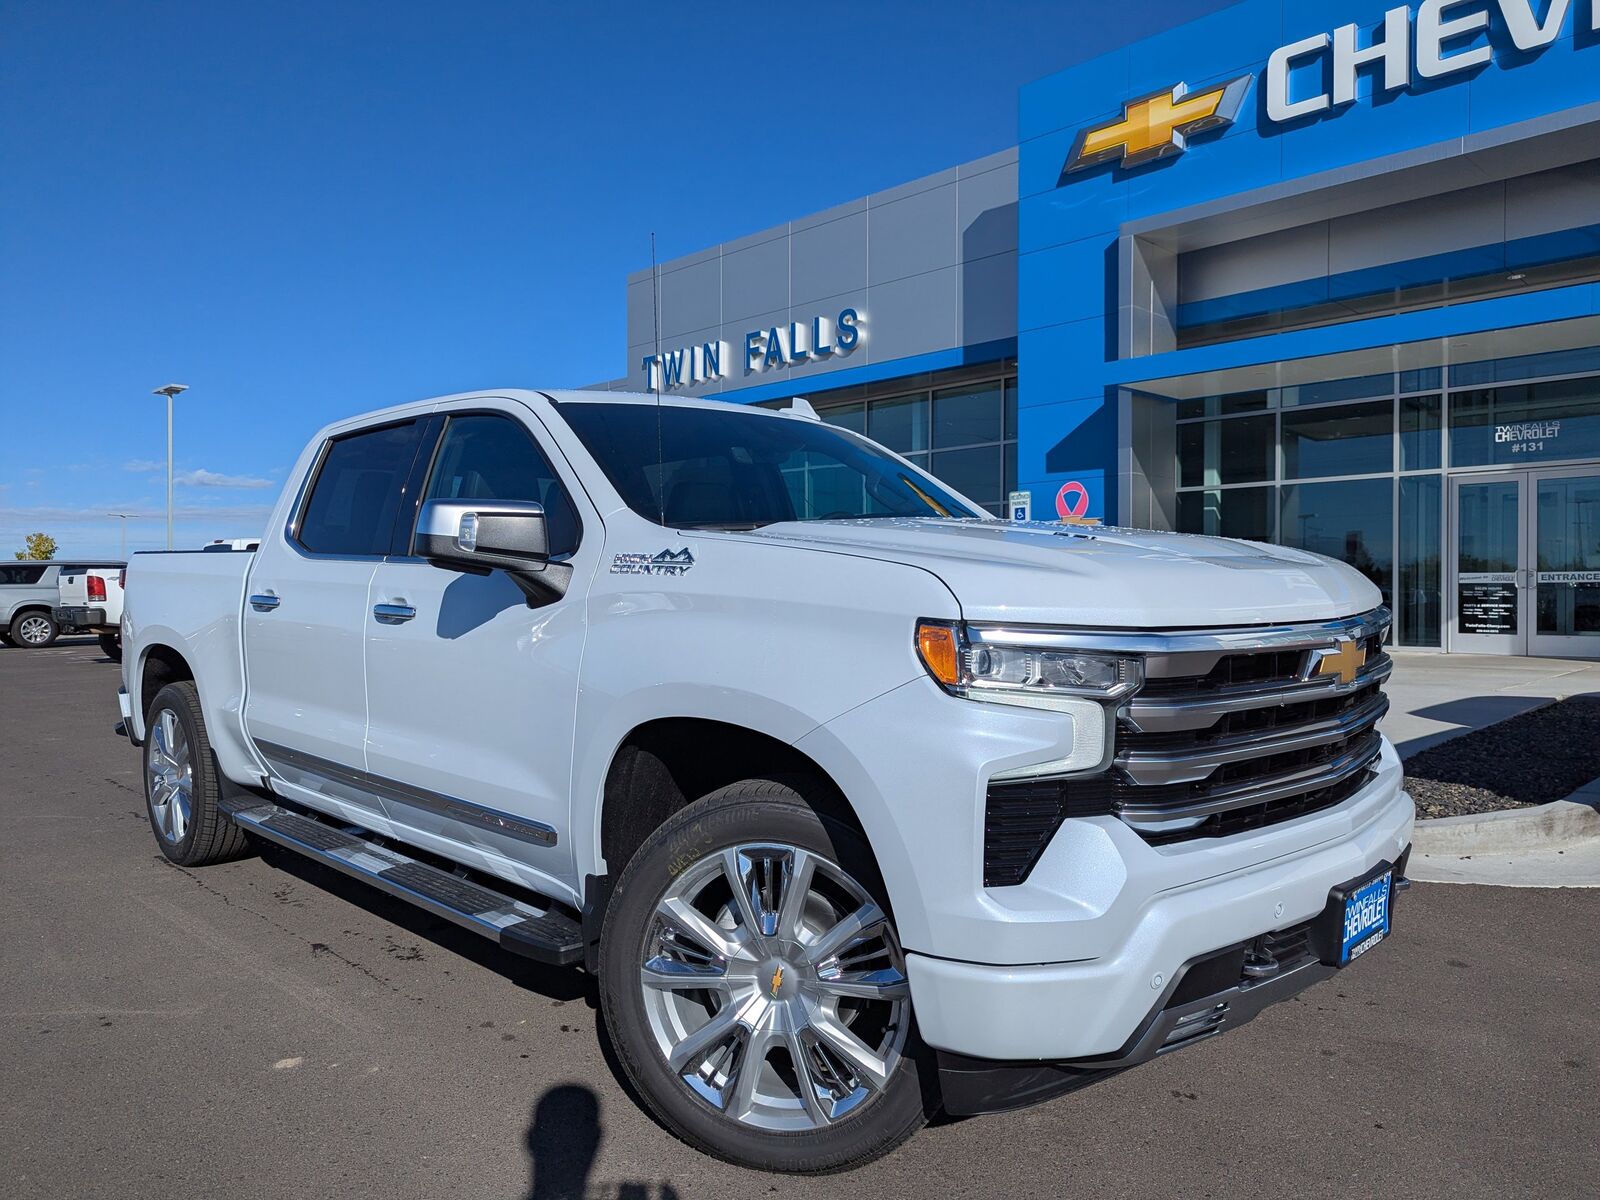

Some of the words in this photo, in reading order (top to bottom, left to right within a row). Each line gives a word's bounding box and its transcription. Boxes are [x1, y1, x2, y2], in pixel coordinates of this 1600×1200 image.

[1266, 0, 1600, 122] CHEV
[642, 340, 723, 391] TWIN
[744, 308, 861, 374] FALLS
[1495, 427, 1560, 443] CHEVROLET
[1511, 441, 1544, 453] #131
[609, 564, 693, 576] COUNTRY
[1541, 573, 1600, 581] ENTRANCE
